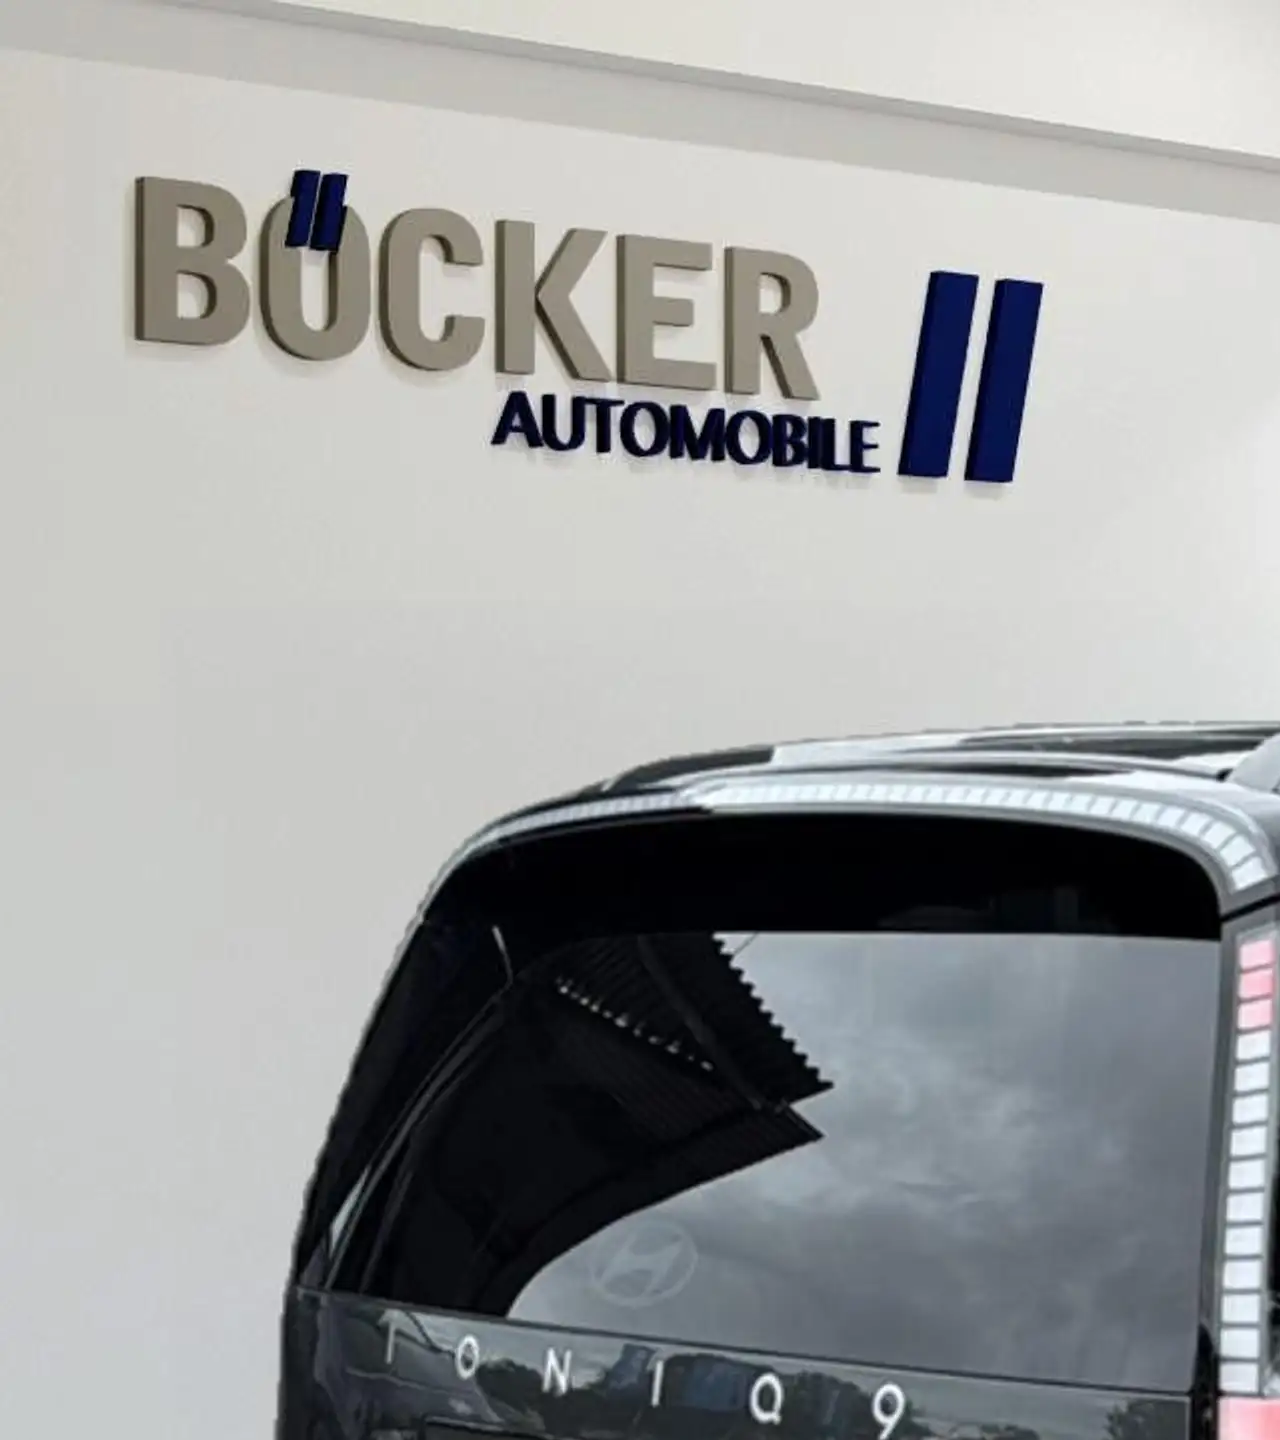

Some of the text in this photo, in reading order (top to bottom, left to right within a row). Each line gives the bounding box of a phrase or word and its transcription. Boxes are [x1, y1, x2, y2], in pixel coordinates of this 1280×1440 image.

[134, 169, 821, 401] BÖCKER
[490, 390, 881, 475] AUTOMOBILE
[872, 1383, 905, 1440] 9
